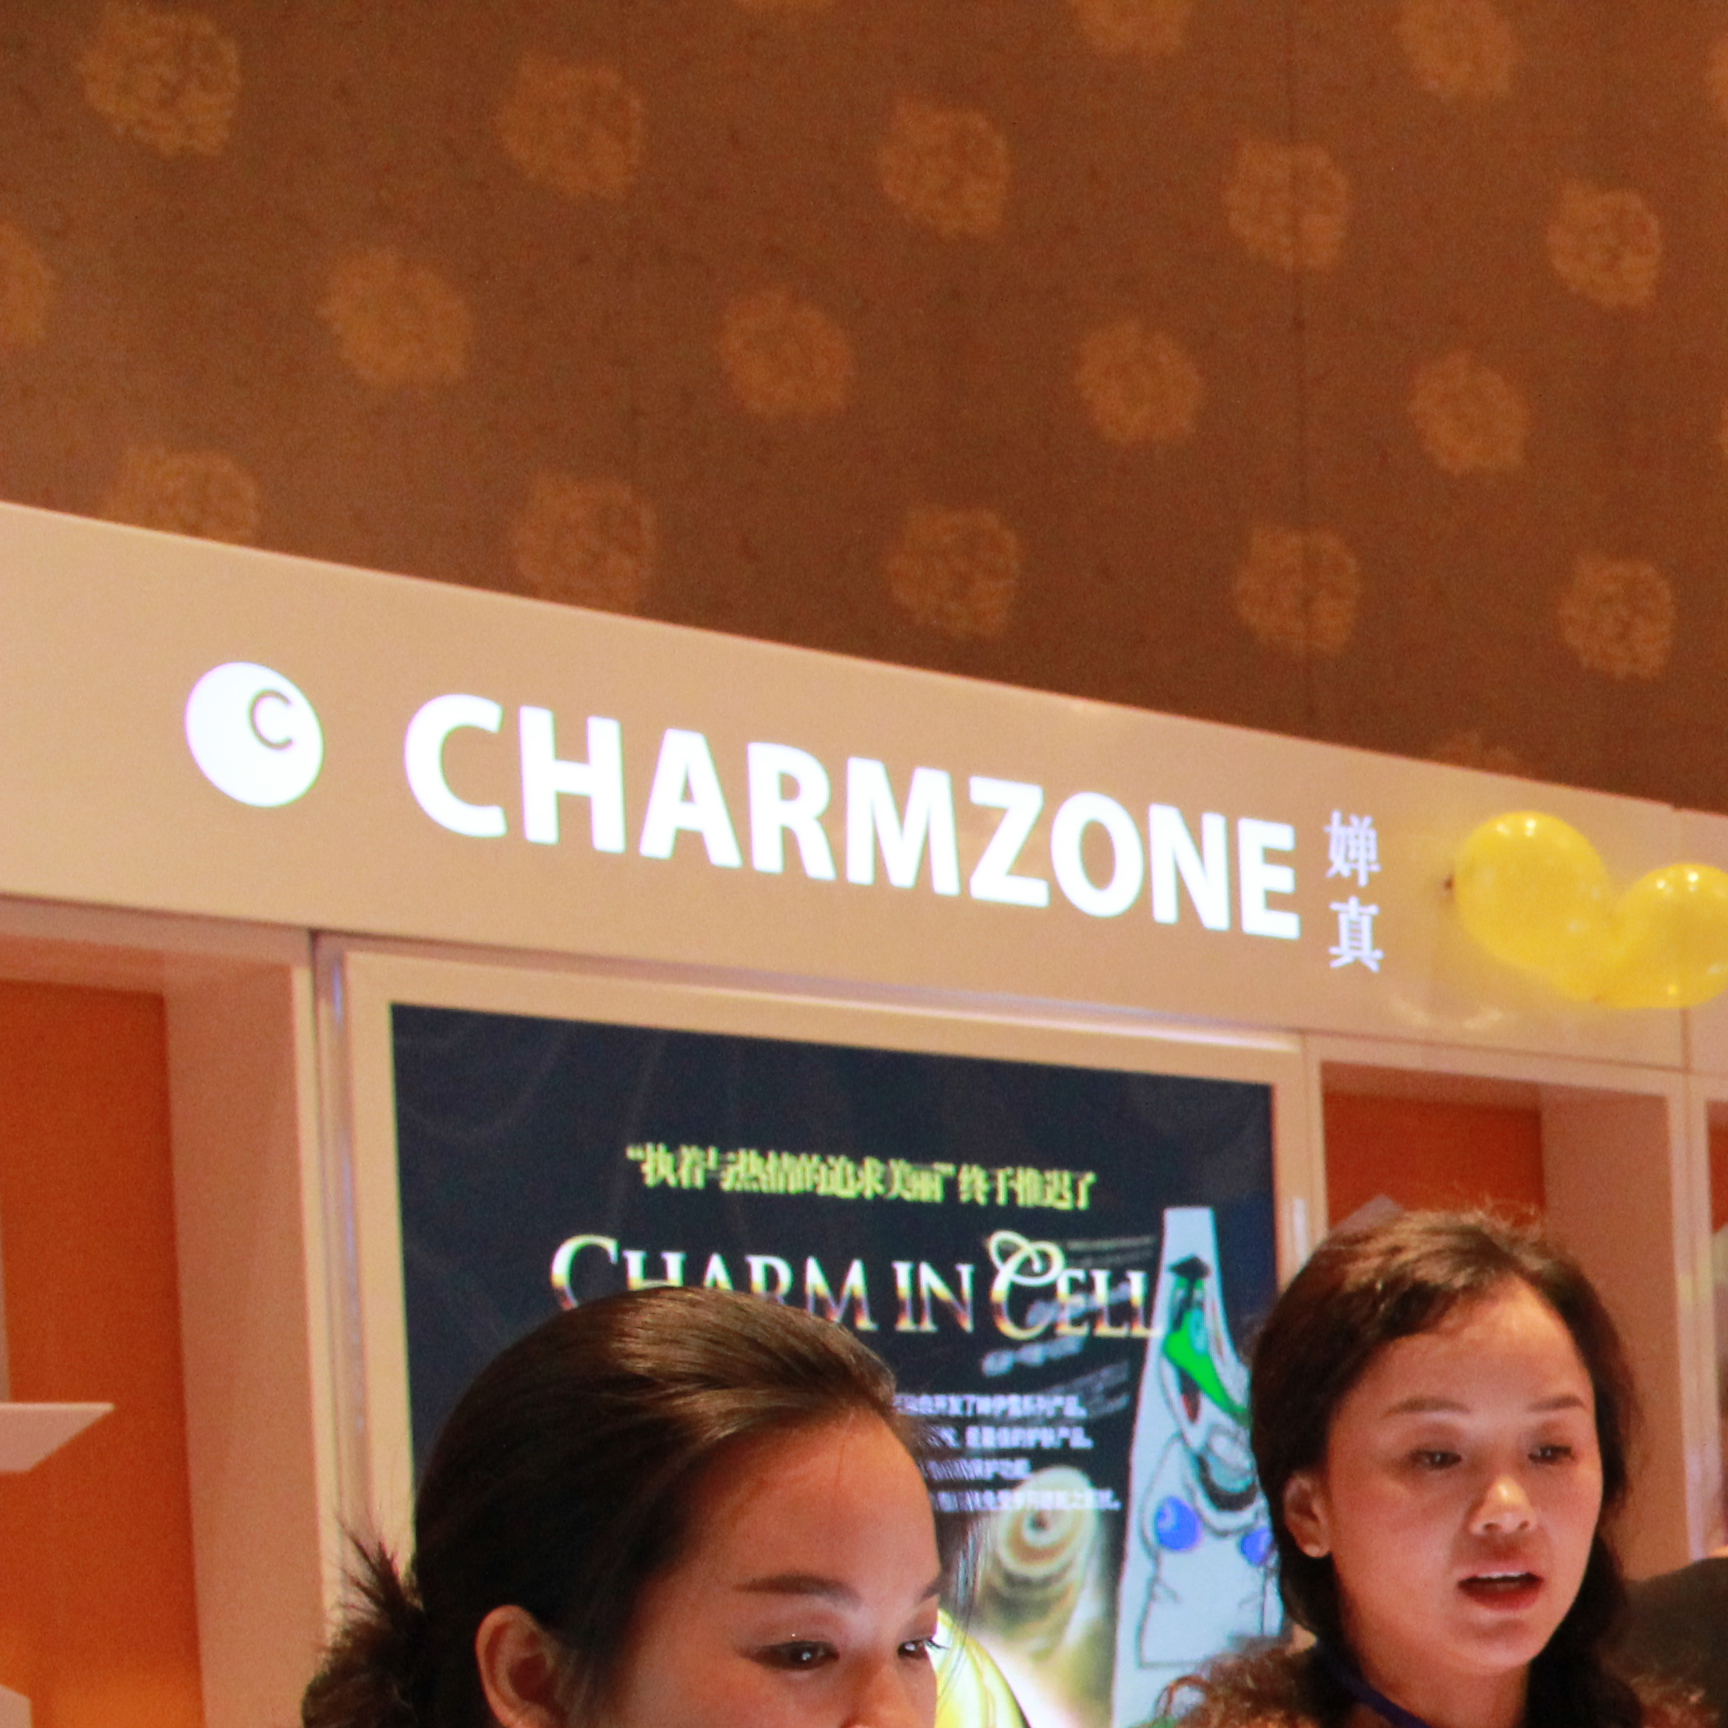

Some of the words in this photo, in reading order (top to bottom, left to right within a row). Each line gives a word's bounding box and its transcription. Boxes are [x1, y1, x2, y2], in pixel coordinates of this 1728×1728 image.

[403, 692, 1301, 940] CHARMZONE
[1323, 809, 1383, 973] 婵真
[892, 1260, 975, 1334] IN
